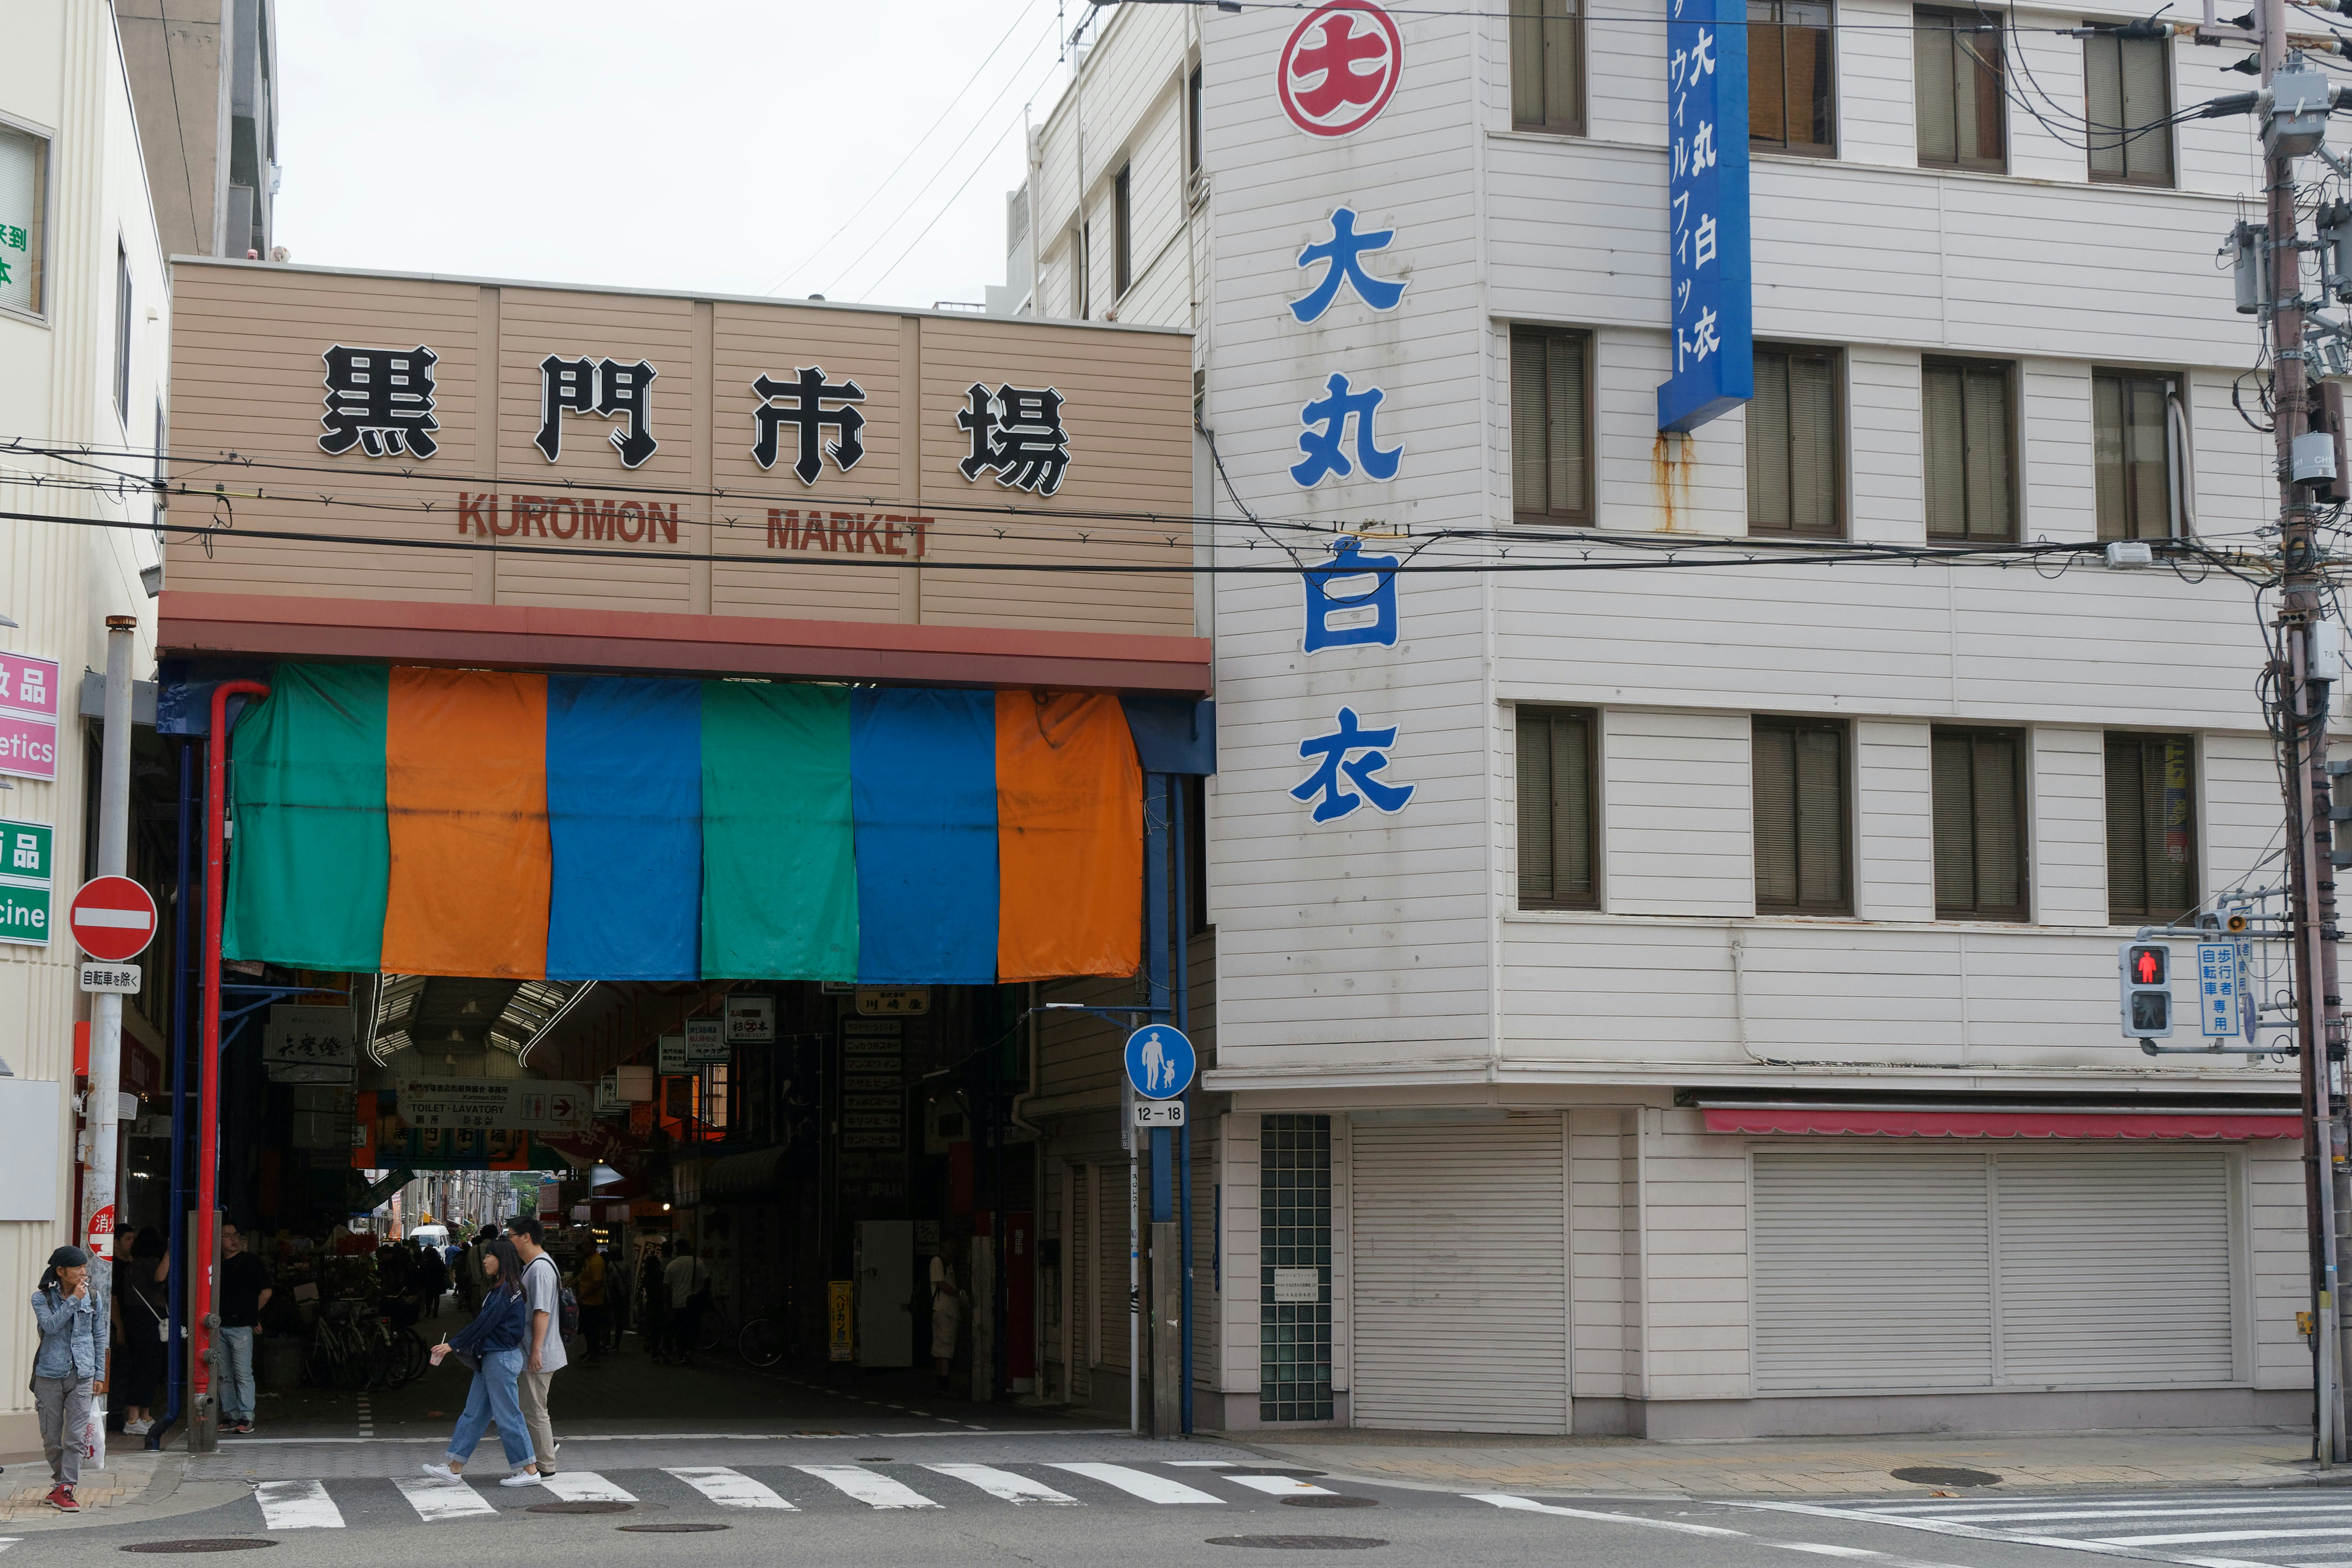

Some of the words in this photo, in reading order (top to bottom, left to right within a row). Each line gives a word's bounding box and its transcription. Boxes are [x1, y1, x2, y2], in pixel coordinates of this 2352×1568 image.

[1689, 27, 1721, 363] 大丸白衣
[318, 344, 1072, 497] 黒門市場
[458, 492, 678, 544] KUROMON
[767, 509, 935, 557] MARKET
[1286, 206, 1418, 826] 大丸白衣
[83, 970, 137, 987] 自転車を除く
[2203, 949, 2218, 996] 自転車
[2218, 949, 2232, 996] 歩行者
[2213, 1000, 2227, 1031] 専用
[411, 1104, 445, 1112] TOILET
[453, 1105, 505, 1114] LAVATORY
[463, 1115, 493, 1126] 화장실
